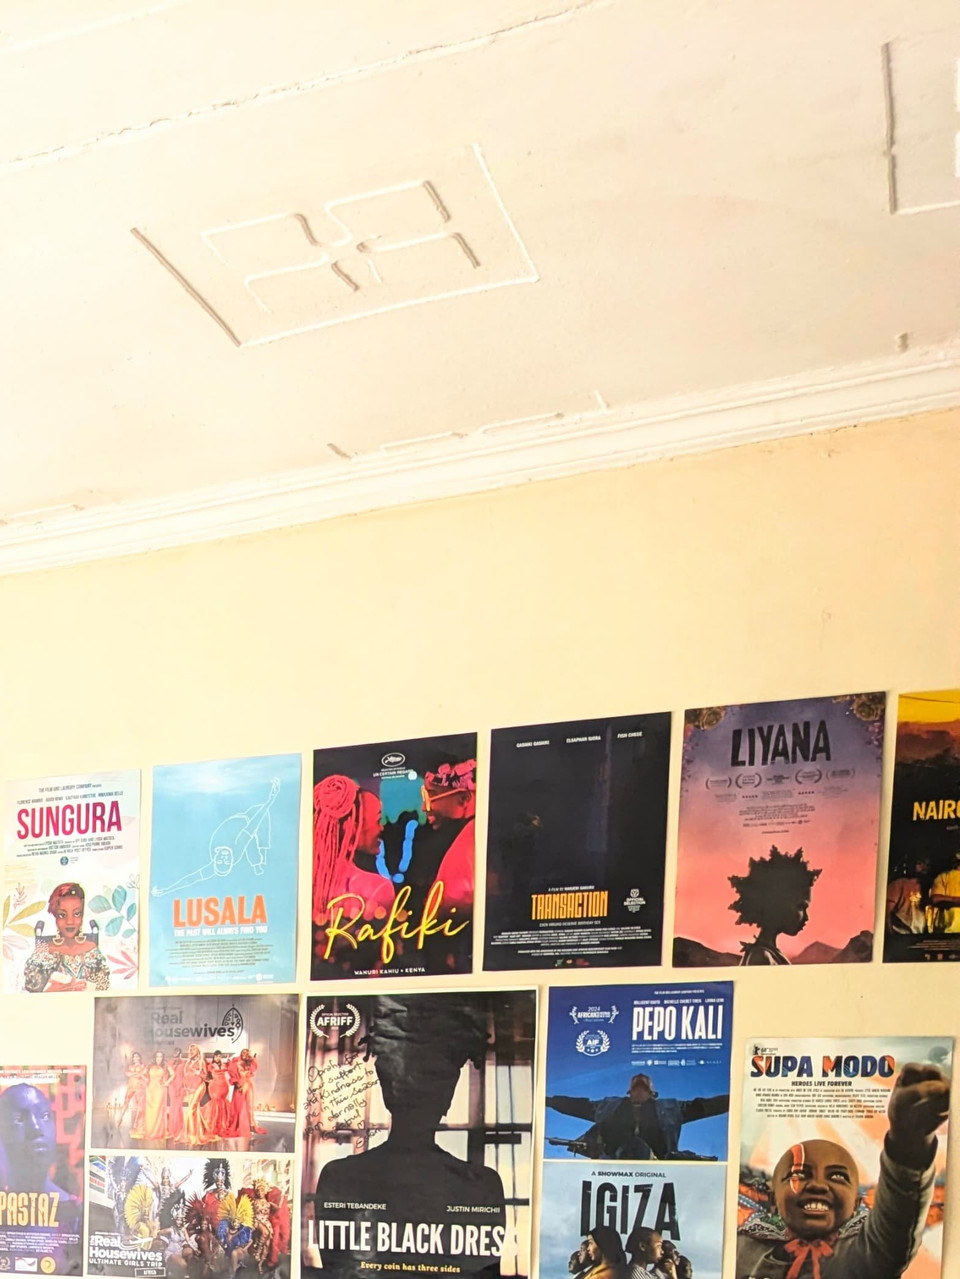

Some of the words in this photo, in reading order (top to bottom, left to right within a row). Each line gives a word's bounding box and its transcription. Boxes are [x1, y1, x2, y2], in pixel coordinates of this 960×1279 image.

[731, 720, 832, 768] LIYANA
[17, 800, 122, 840] SUNGURA
[173, 894, 268, 929] LUSALA
[531, 890, 608, 920] TRANSACTION
[324, 880, 470, 964] Rafiki
[151, 1010, 184, 1025] Real
[317, 1016, 353, 1027] AFRIFF
[631, 1005, 677, 1041] PEPO
[681, 1004, 724, 1040] KALI
[750, 1055, 814, 1078] SUPA
[821, 1055, 895, 1078] MODO
[323, 1202, 346, 1210] ESTERI
[347, 1202, 387, 1210] TEBANDEKE
[446, 1205, 470, 1213] JUSTIN
[580, 1180, 681, 1241] IGIZA
[95, 1235, 121, 1247] Real
[308, 1219, 371, 1252] LITTLE
[377, 1222, 444, 1255] BLACK
[89, 1246, 163, 1261] Housewives
[89, 1258, 122, 1266] ULTIMATE
[360, 1261, 382, 1271] Every
[402, 1263, 416, 1271] has
[417, 1264, 439, 1272] three
[440, 1265, 461, 1273] sides
